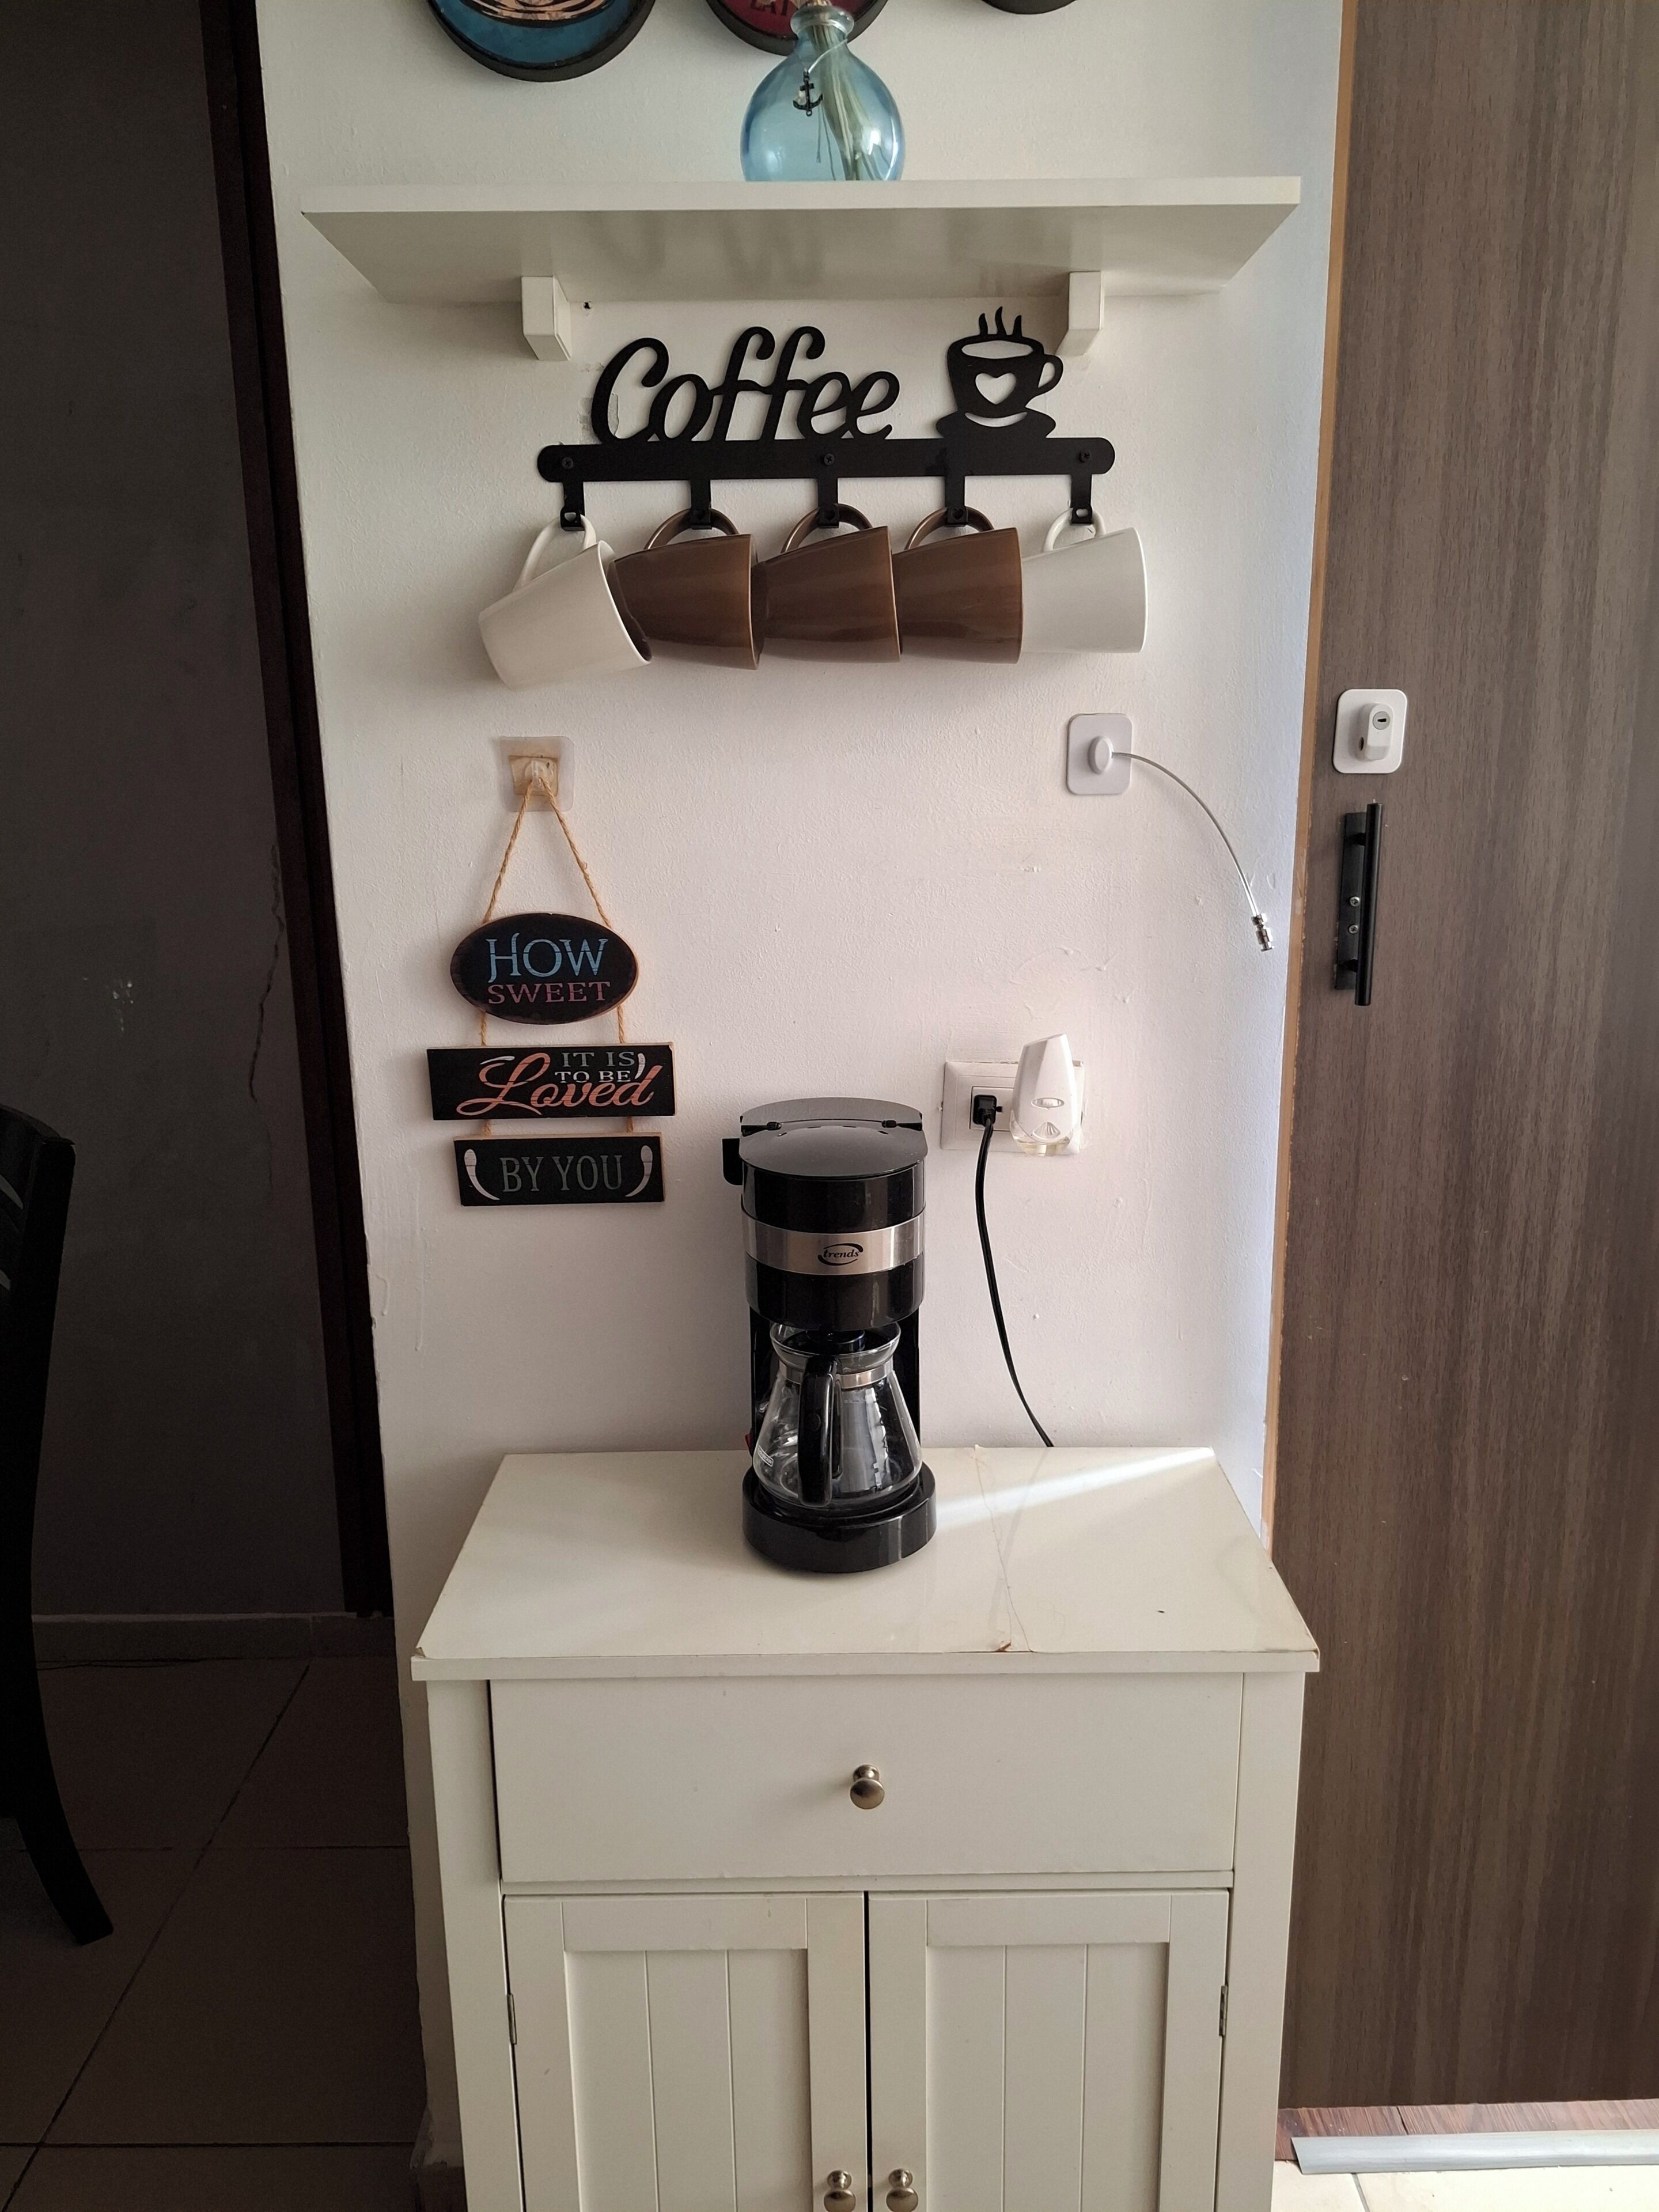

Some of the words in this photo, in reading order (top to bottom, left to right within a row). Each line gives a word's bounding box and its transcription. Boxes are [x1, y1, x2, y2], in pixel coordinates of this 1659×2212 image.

[591, 326, 900, 441] Coffee
[485, 933, 608, 983] HOW
[487, 981, 611, 1005] SWEET
[561, 1051, 594, 1067] IT
[607, 1051, 635, 1066] IS
[456, 1052, 663, 1116] Loved
[554, 1070, 590, 1084] TO
[599, 1070, 631, 1083] BE
[499, 1157, 544, 1192] BY
[552, 1154, 623, 1191] YOU
[823, 1249, 859, 1259] trends
